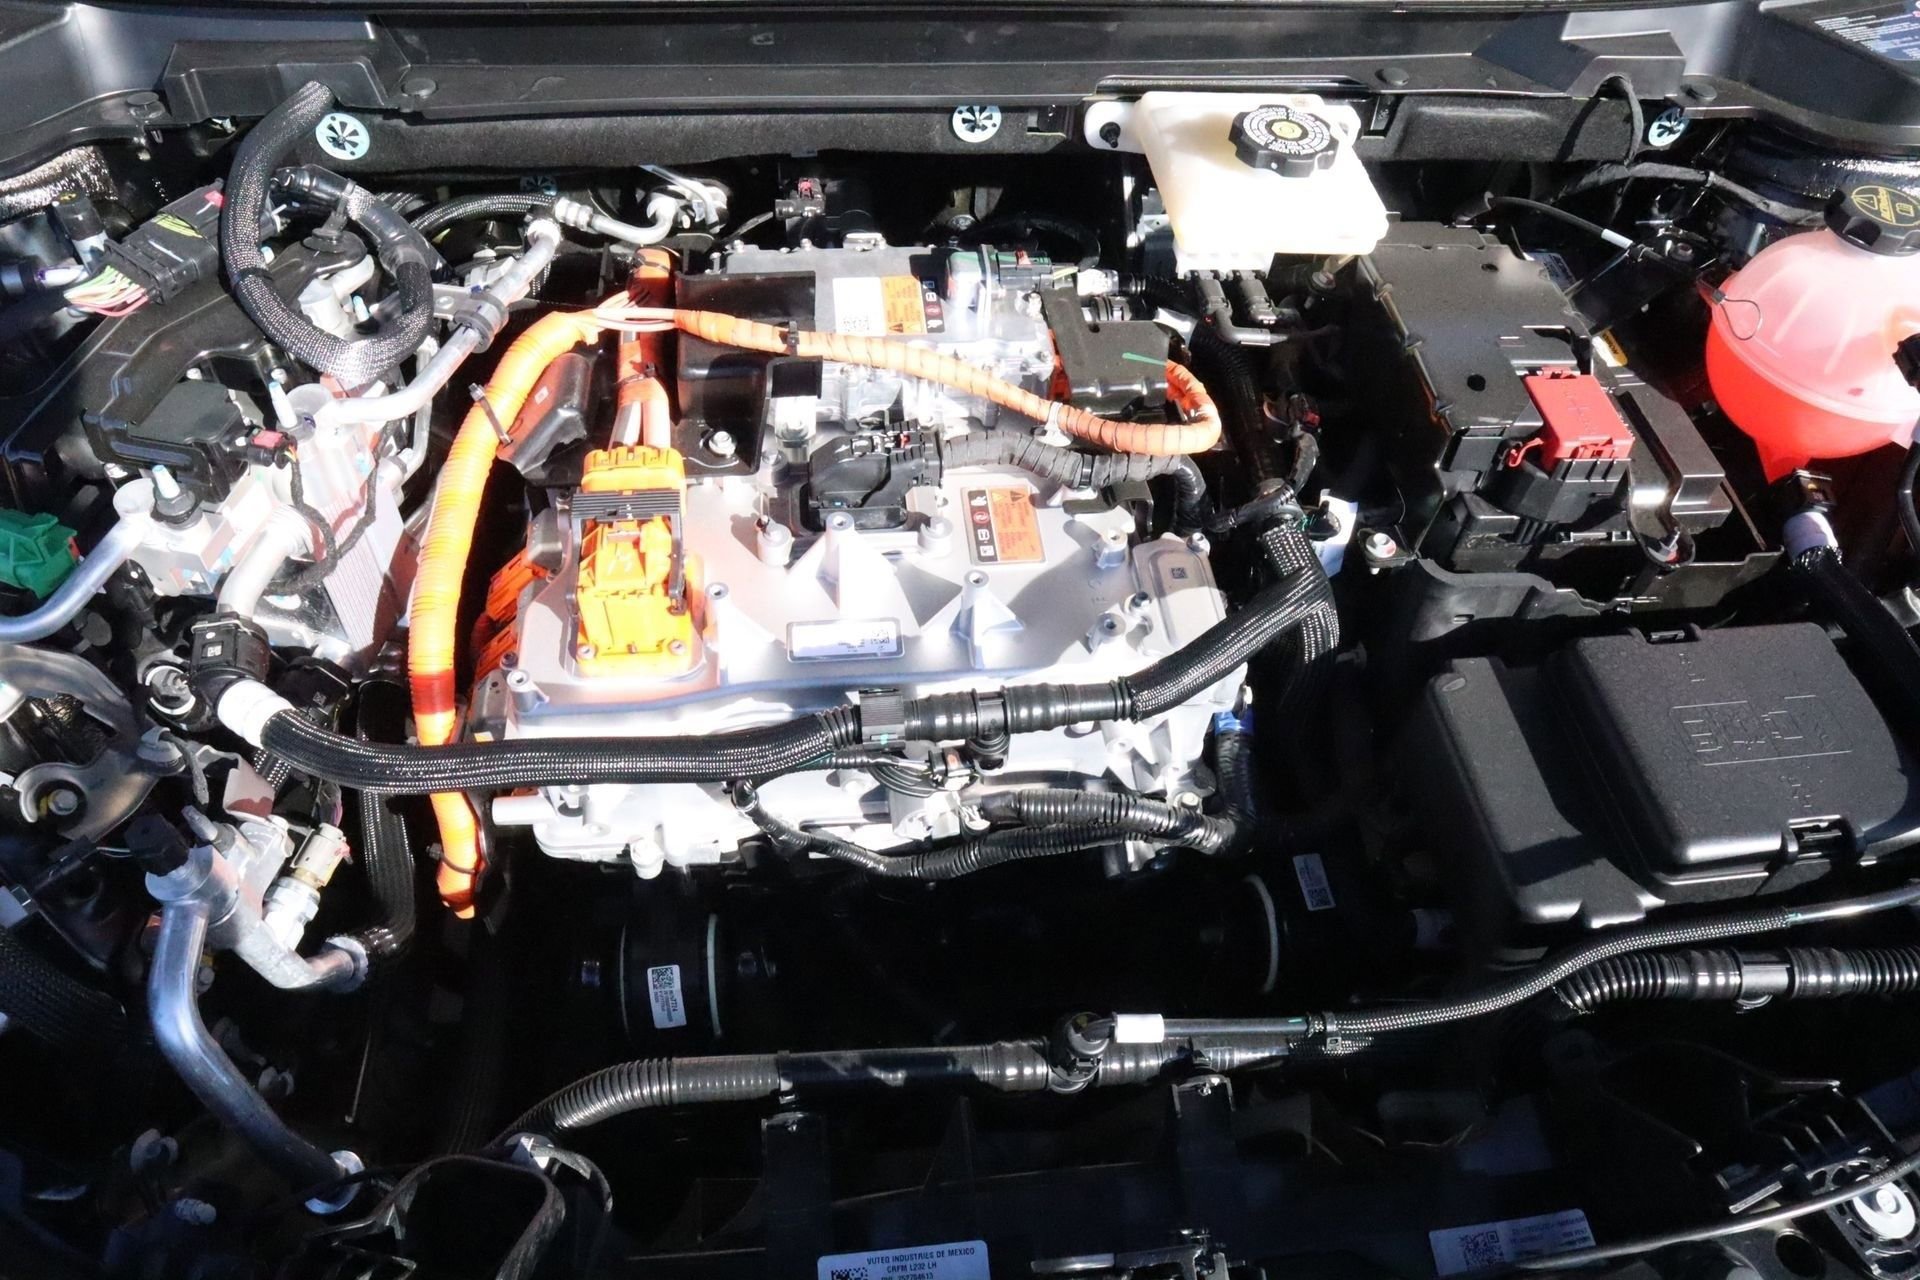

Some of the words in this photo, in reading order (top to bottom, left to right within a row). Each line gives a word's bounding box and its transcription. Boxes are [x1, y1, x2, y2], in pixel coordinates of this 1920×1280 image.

[892, 1252, 934, 1262] INDUSTRIES
[936, 1250, 945, 1258] DE
[948, 1248, 975, 1256] MEXICO
